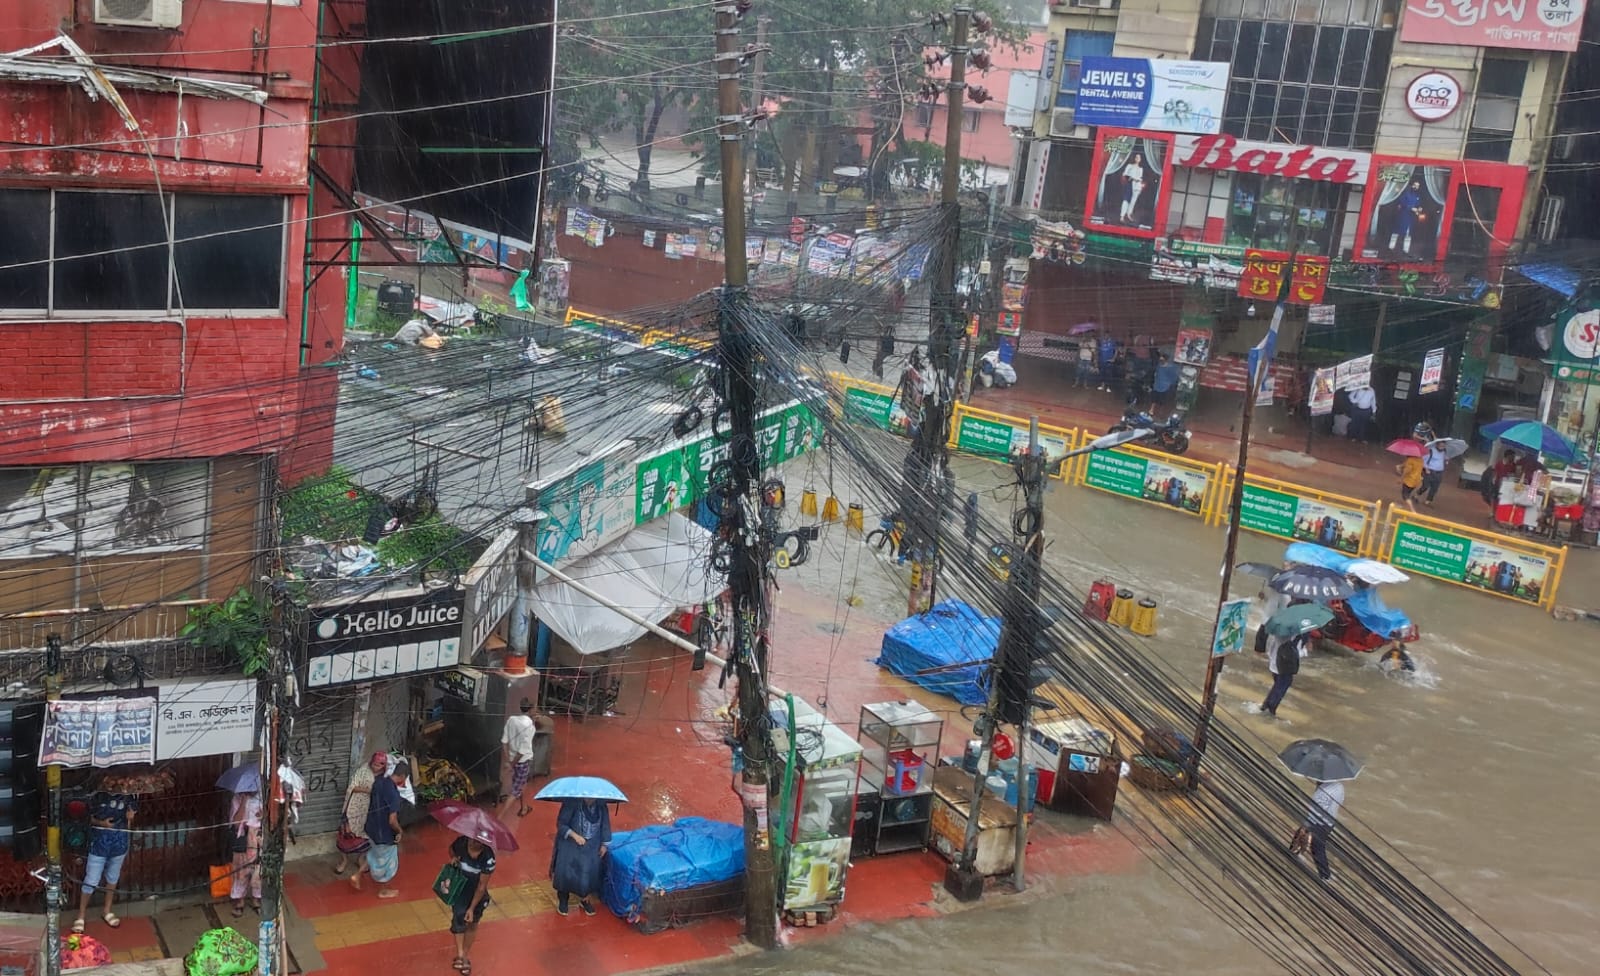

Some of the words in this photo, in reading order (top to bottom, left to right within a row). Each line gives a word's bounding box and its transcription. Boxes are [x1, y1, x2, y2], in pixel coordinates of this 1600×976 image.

[1544, 10, 1573, 23] তলা
[1081, 70, 1146, 88] JEWEL'S
[1080, 88, 1110, 98] DENTAL
[1112, 91, 1144, 100] AVENUE
[1180, 133, 1359, 183] Bata
[1284, 582, 1339, 596] POLICE
[343, 611, 402, 635] Hello
[406, 604, 459, 626] Juice
[199, 705, 237, 718] মেডিকেল
[240, 705, 254, 713] হল
